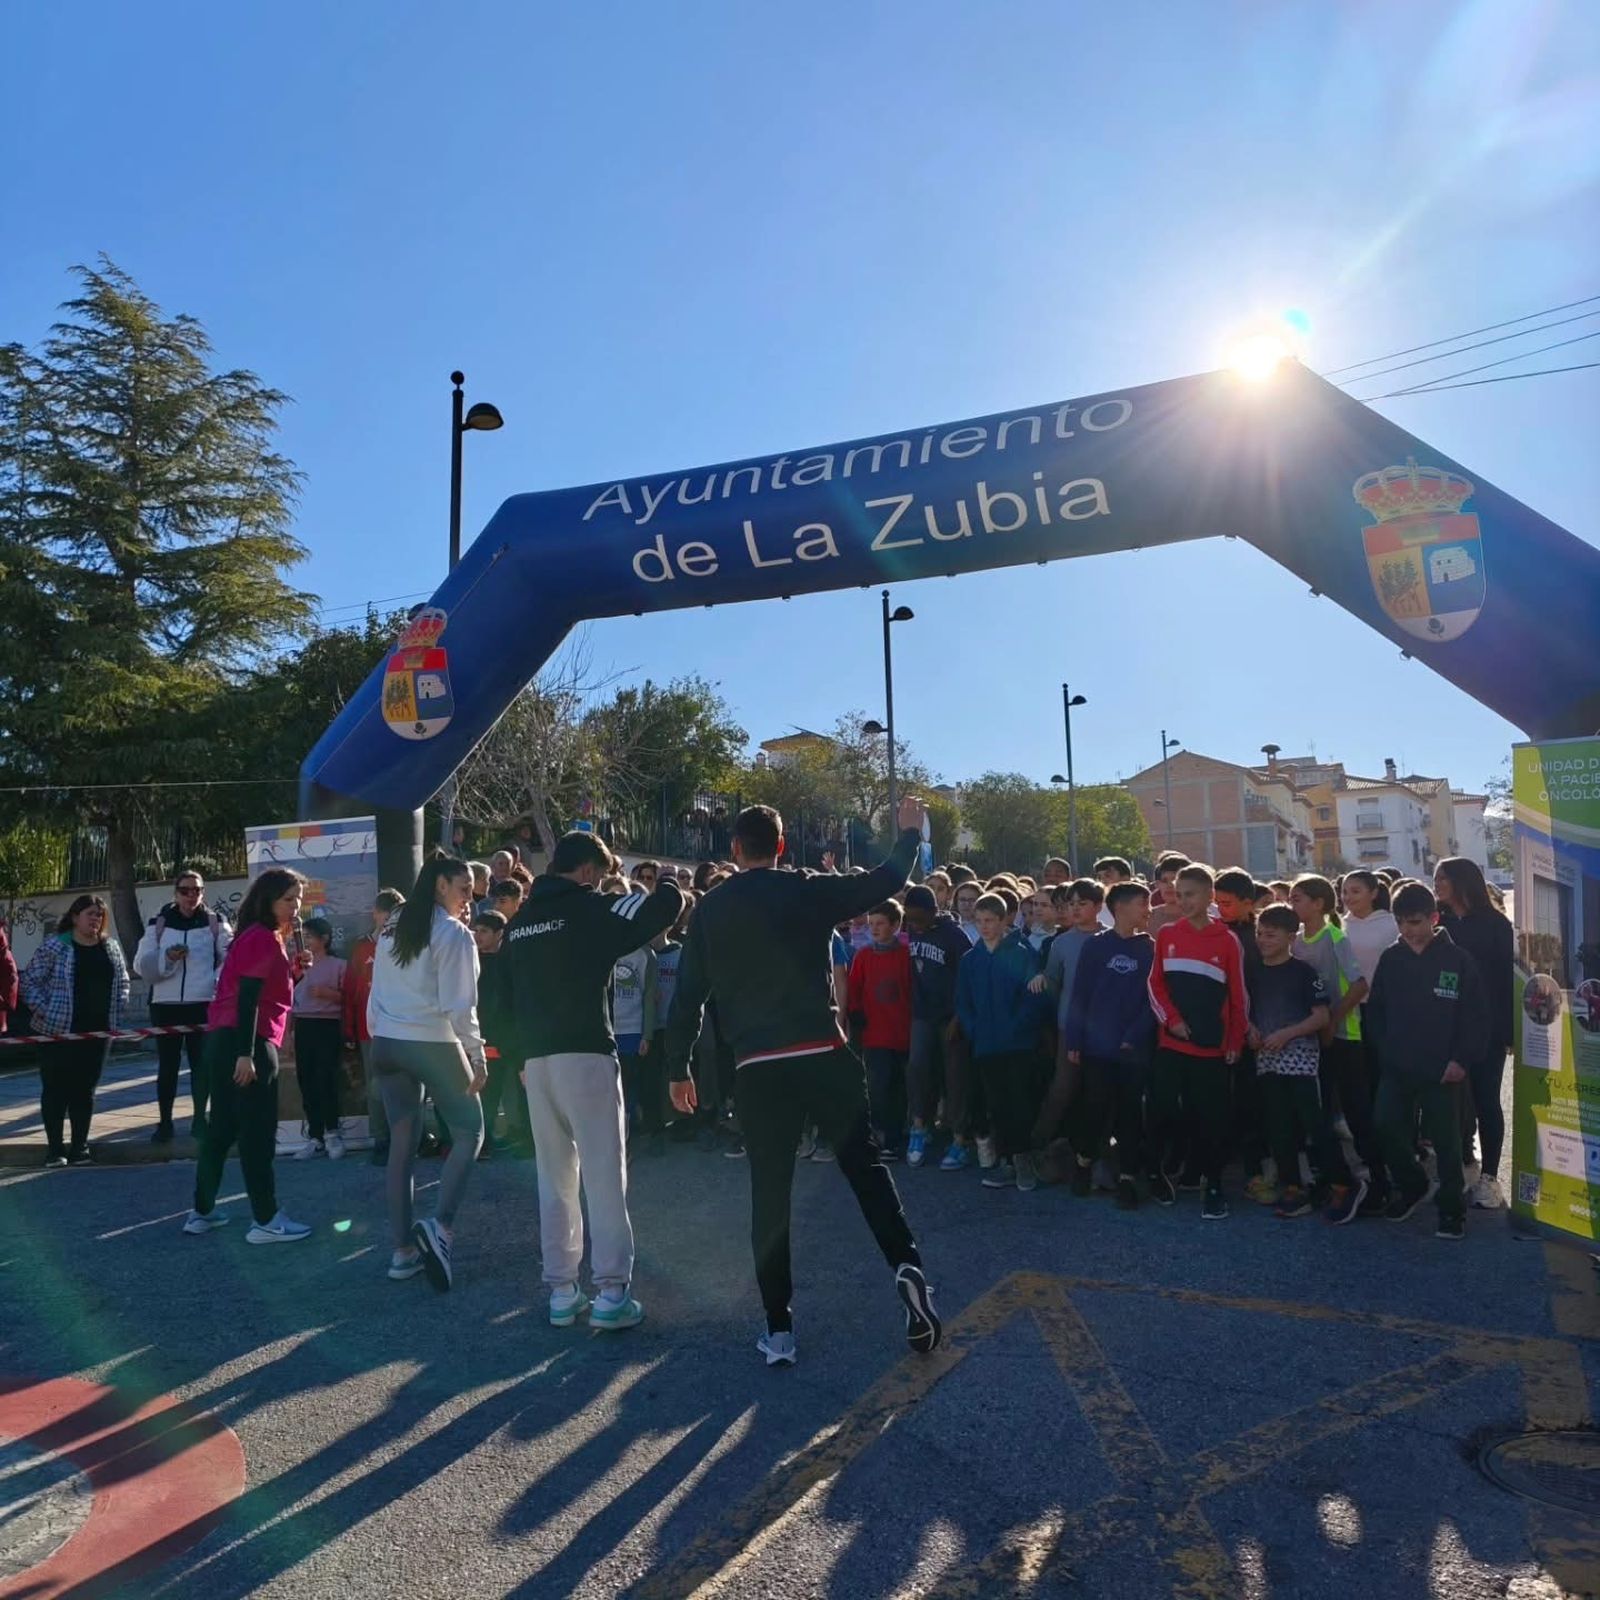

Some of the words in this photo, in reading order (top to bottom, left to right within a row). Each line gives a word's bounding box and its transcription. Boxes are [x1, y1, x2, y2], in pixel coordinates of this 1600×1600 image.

[582, 398, 1135, 526] Ayuntamiento
[632, 533, 719, 583] de
[743, 519, 840, 569] La
[864, 471, 1111, 552] Zubia
[1528, 758, 1585, 773] UNIDAD
[920, 941, 946, 965] YORK
